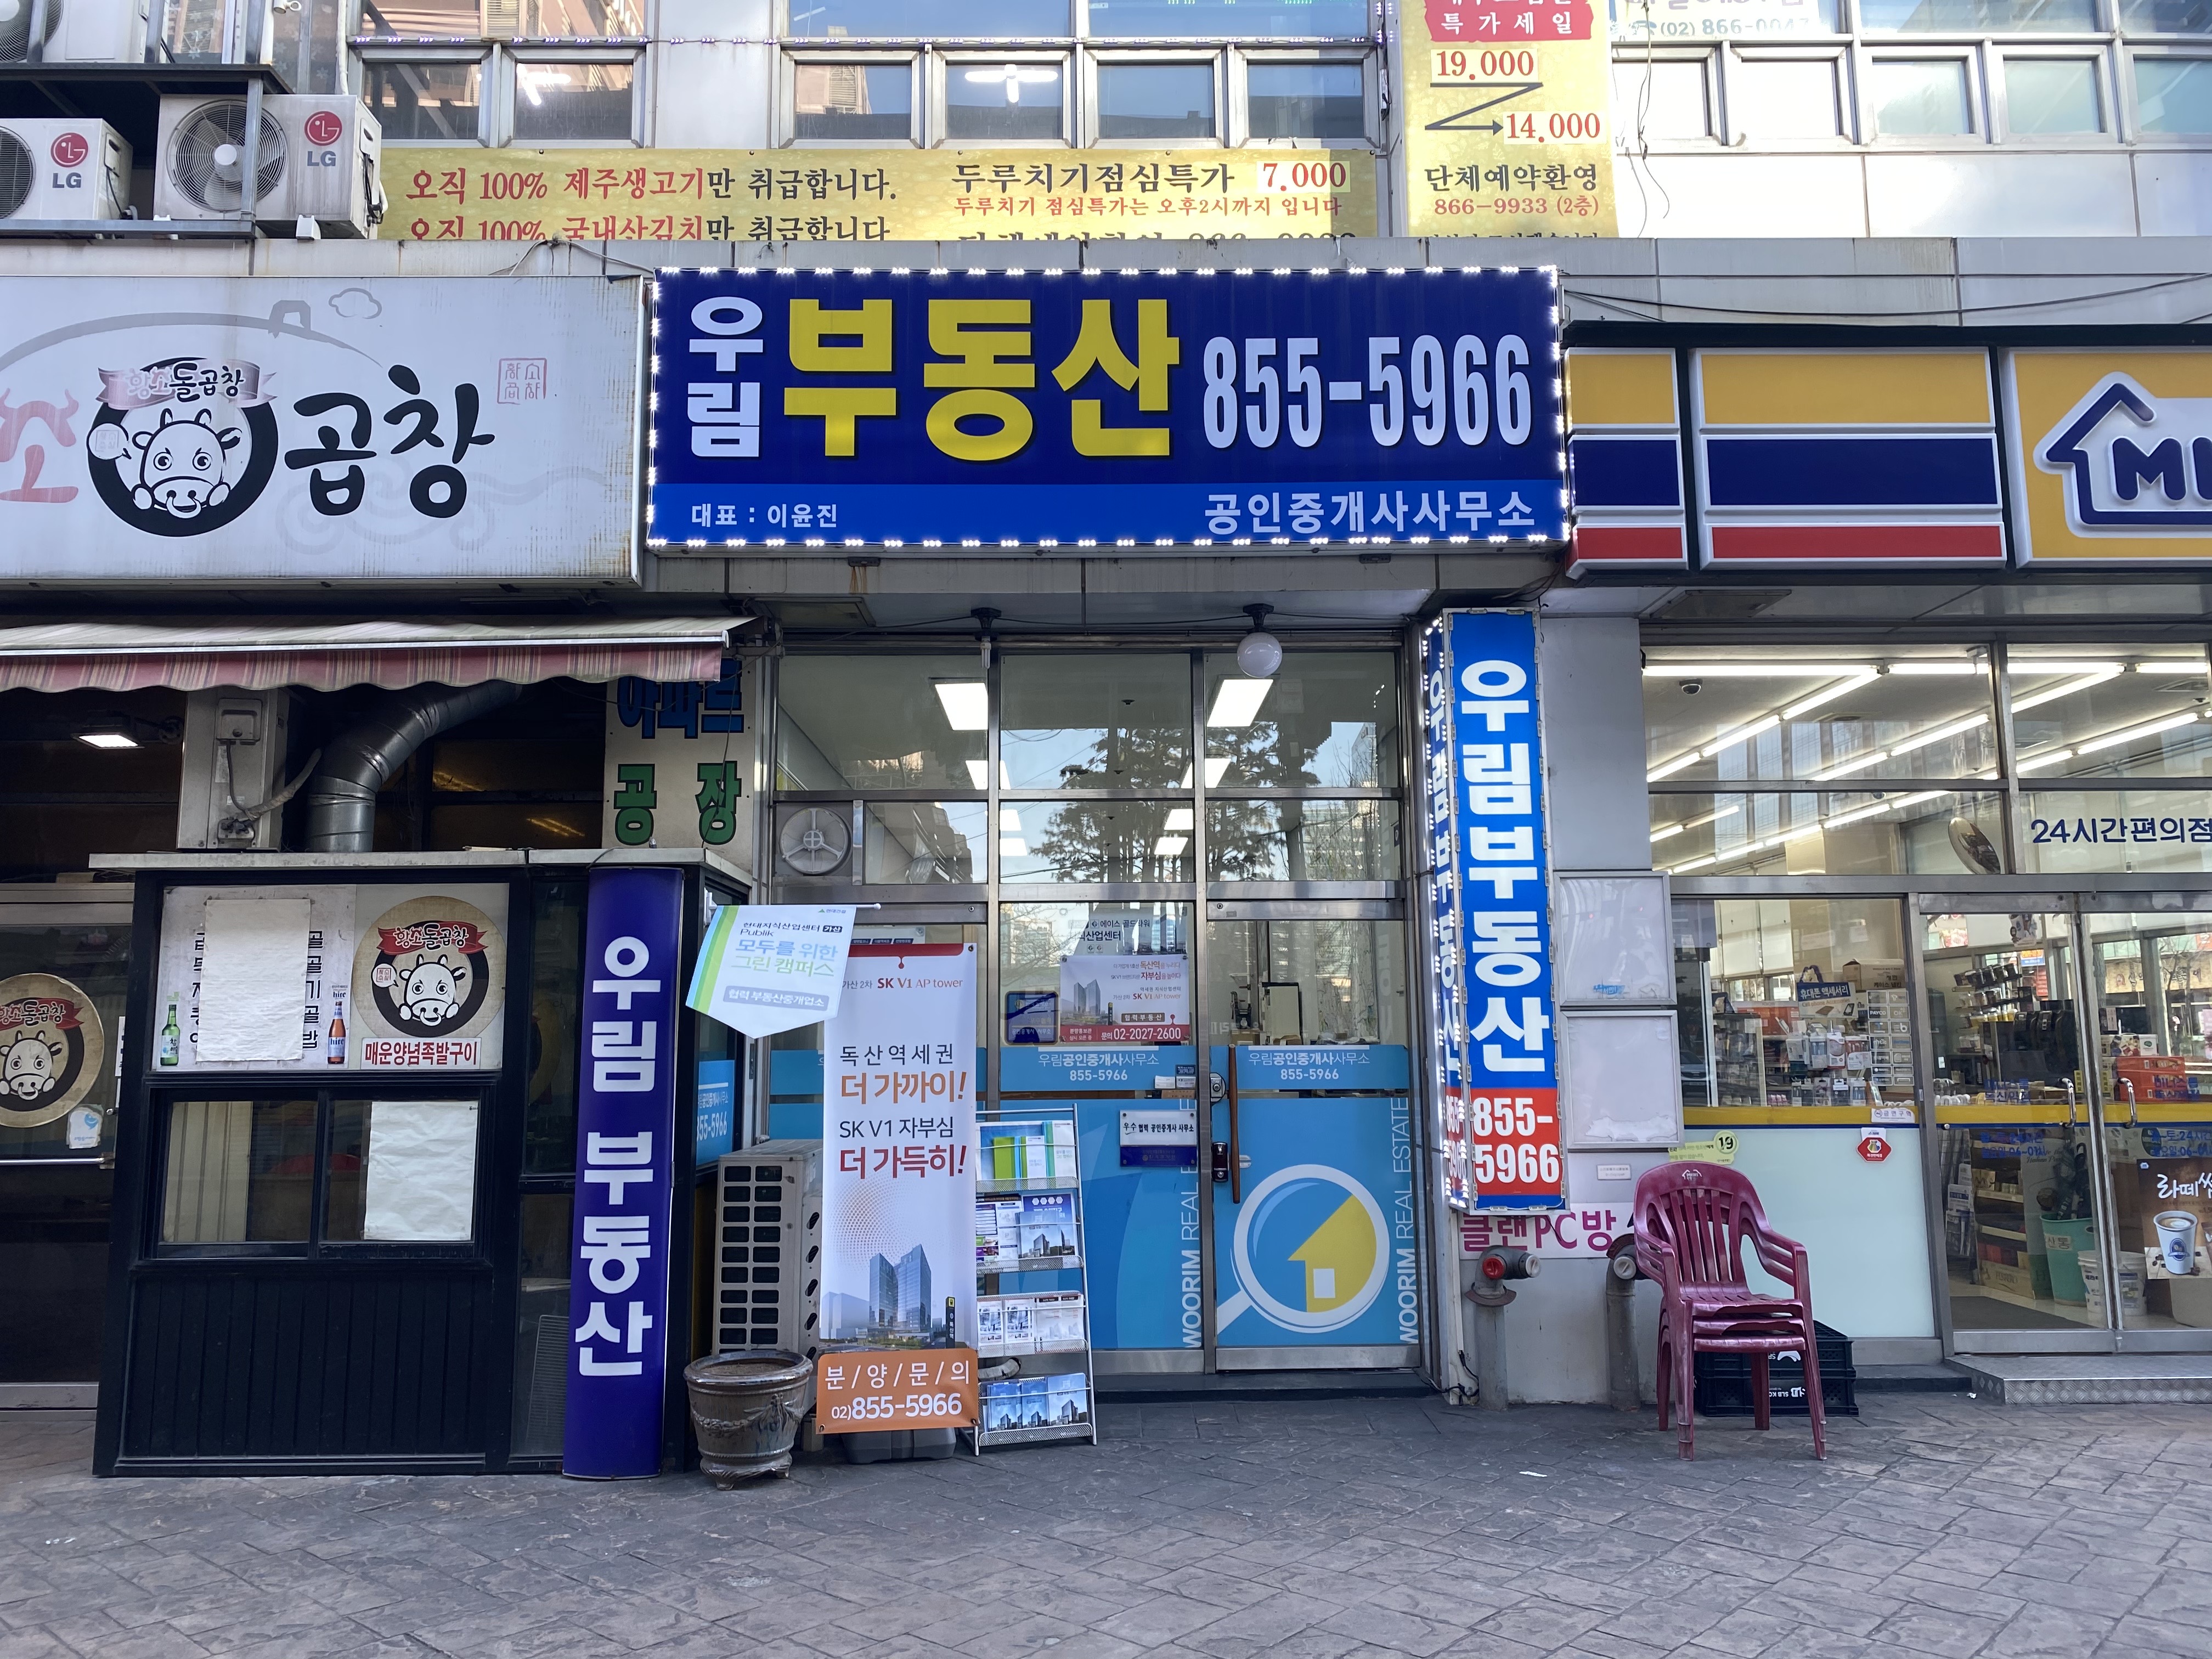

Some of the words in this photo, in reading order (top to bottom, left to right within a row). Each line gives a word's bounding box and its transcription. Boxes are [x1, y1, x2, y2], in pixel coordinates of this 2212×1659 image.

[1441, 12, 1572, 35] 특가세일
[1436, 50, 1534, 81] 19.000
[1506, 112, 1601, 143] 14.000
[307, 150, 336, 167] LG
[53, 172, 82, 188] LG
[406, 167, 466, 205] 오직
[479, 171, 548, 200] 100%
[563, 167, 736, 201] 제주생고기만
[748, 167, 896, 201] 취급합니다.
[951, 163, 1235, 194] 두루치기점심특가
[1263, 162, 1346, 192] 7.000
[1426, 164, 1598, 193] 단체예약환영
[954, 197, 1035, 216] 두루치기
[1046, 197, 1148, 216] 점심특가는
[1156, 197, 1271, 216] 오후2시까지
[1282, 197, 1342, 217] 입니다
[1434, 198, 1549, 216] 866-9933
[1556, 195, 1599, 217] (2층)
[687, 296, 763, 459] 우림
[783, 298, 1181, 462] 부동산
[1203, 333, 1532, 450] 855-5966
[0, 388, 78, 504] 소
[284, 364, 495, 518] 곱창
[691, 503, 738, 528] 대표
[766, 503, 838, 529] 이윤진
[1204, 490, 1537, 537] 공인중개사사무소
[613, 761, 742, 845] 공장
[2031, 818, 2212, 843] 24시간편의점
[1461, 660, 1550, 1073] 우림부동산
[393, 922, 469, 951] 황소돌곱창
[736, 939, 795, 956] 모두를
[799, 943, 838, 961] 위한
[878, 978, 894, 989] SK
[898, 978, 912, 988] V1
[916, 979, 930, 988] AP
[933, 979, 963, 988] tower
[1800, 987, 1821, 1000] 휴대폰
[1821, 985, 1849, 997] 액세서리
[592, 936, 661, 1092] 우림
[1101, 1032, 1113, 1040] 문의
[1114, 1028, 1181, 1040] 02-2027-2600
[365, 1041, 477, 1065] 매운양념족발구이
[840, 1043, 953, 1066] 독산역세권
[1038, 1053, 1160, 1067] 우림공인중개사사무소
[1248, 1052, 1370, 1066] 우림공인중개사사무소
[842, 1073, 867, 1105] 더
[874, 1070, 967, 1104] 가까이!
[1070, 1070, 1128, 1081] 855-5966
[1280, 1069, 1339, 1080] 855-5966
[839, 1120, 865, 1138] SK
[868, 1120, 893, 1137] V1
[899, 1116, 954, 1139] 자부심
[1138, 1124, 1149, 1133] 협력
[1151, 1123, 1177, 1133] 공인중개사
[1179, 1123, 1194, 1132] 사무소
[1473, 1097, 1553, 1136] 855-
[1390, 1097, 1412, 1173] ESTATE
[1718, 1136, 1734, 1150] 19
[840, 1147, 866, 1180] 더
[873, 1144, 967, 1178] 가득히!
[1475, 1143, 1560, 1184] 5966
[1181, 1182, 1199, 1240] REAL
[1395, 1181, 1414, 1239] REAL
[575, 1131, 653, 1376] 부동산
[1182, 1250, 1203, 1348] WOORIM
[1397, 1249, 1419, 1344] WOORIM
[831, 1392, 963, 1421] 02)855-5966
